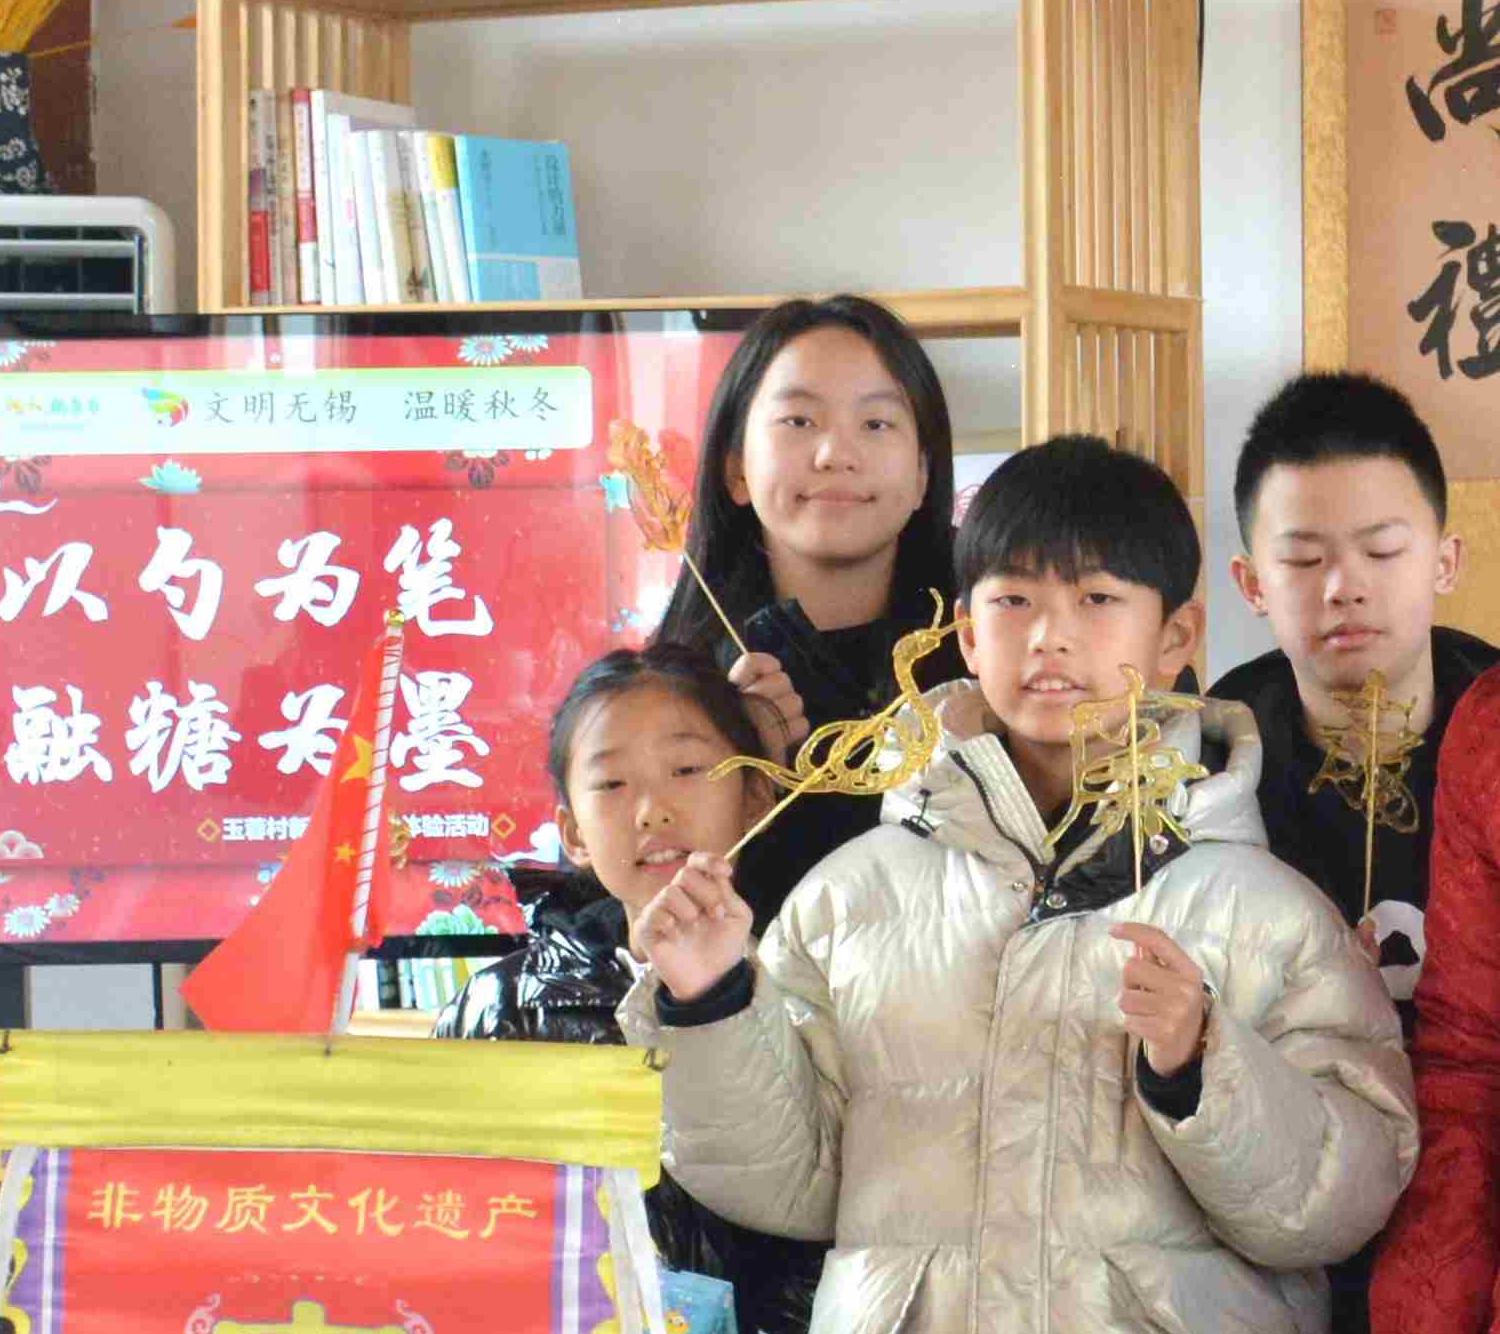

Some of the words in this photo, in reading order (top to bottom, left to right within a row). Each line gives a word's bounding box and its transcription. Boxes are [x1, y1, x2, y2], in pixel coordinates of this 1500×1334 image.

[207, 388, 357, 424] 文明无锡
[404, 386, 558, 423] 温暖秋冬
[3, 671, 490, 793] 融糖为墨
[87, 1183, 539, 1240] 非物质文化遗产
